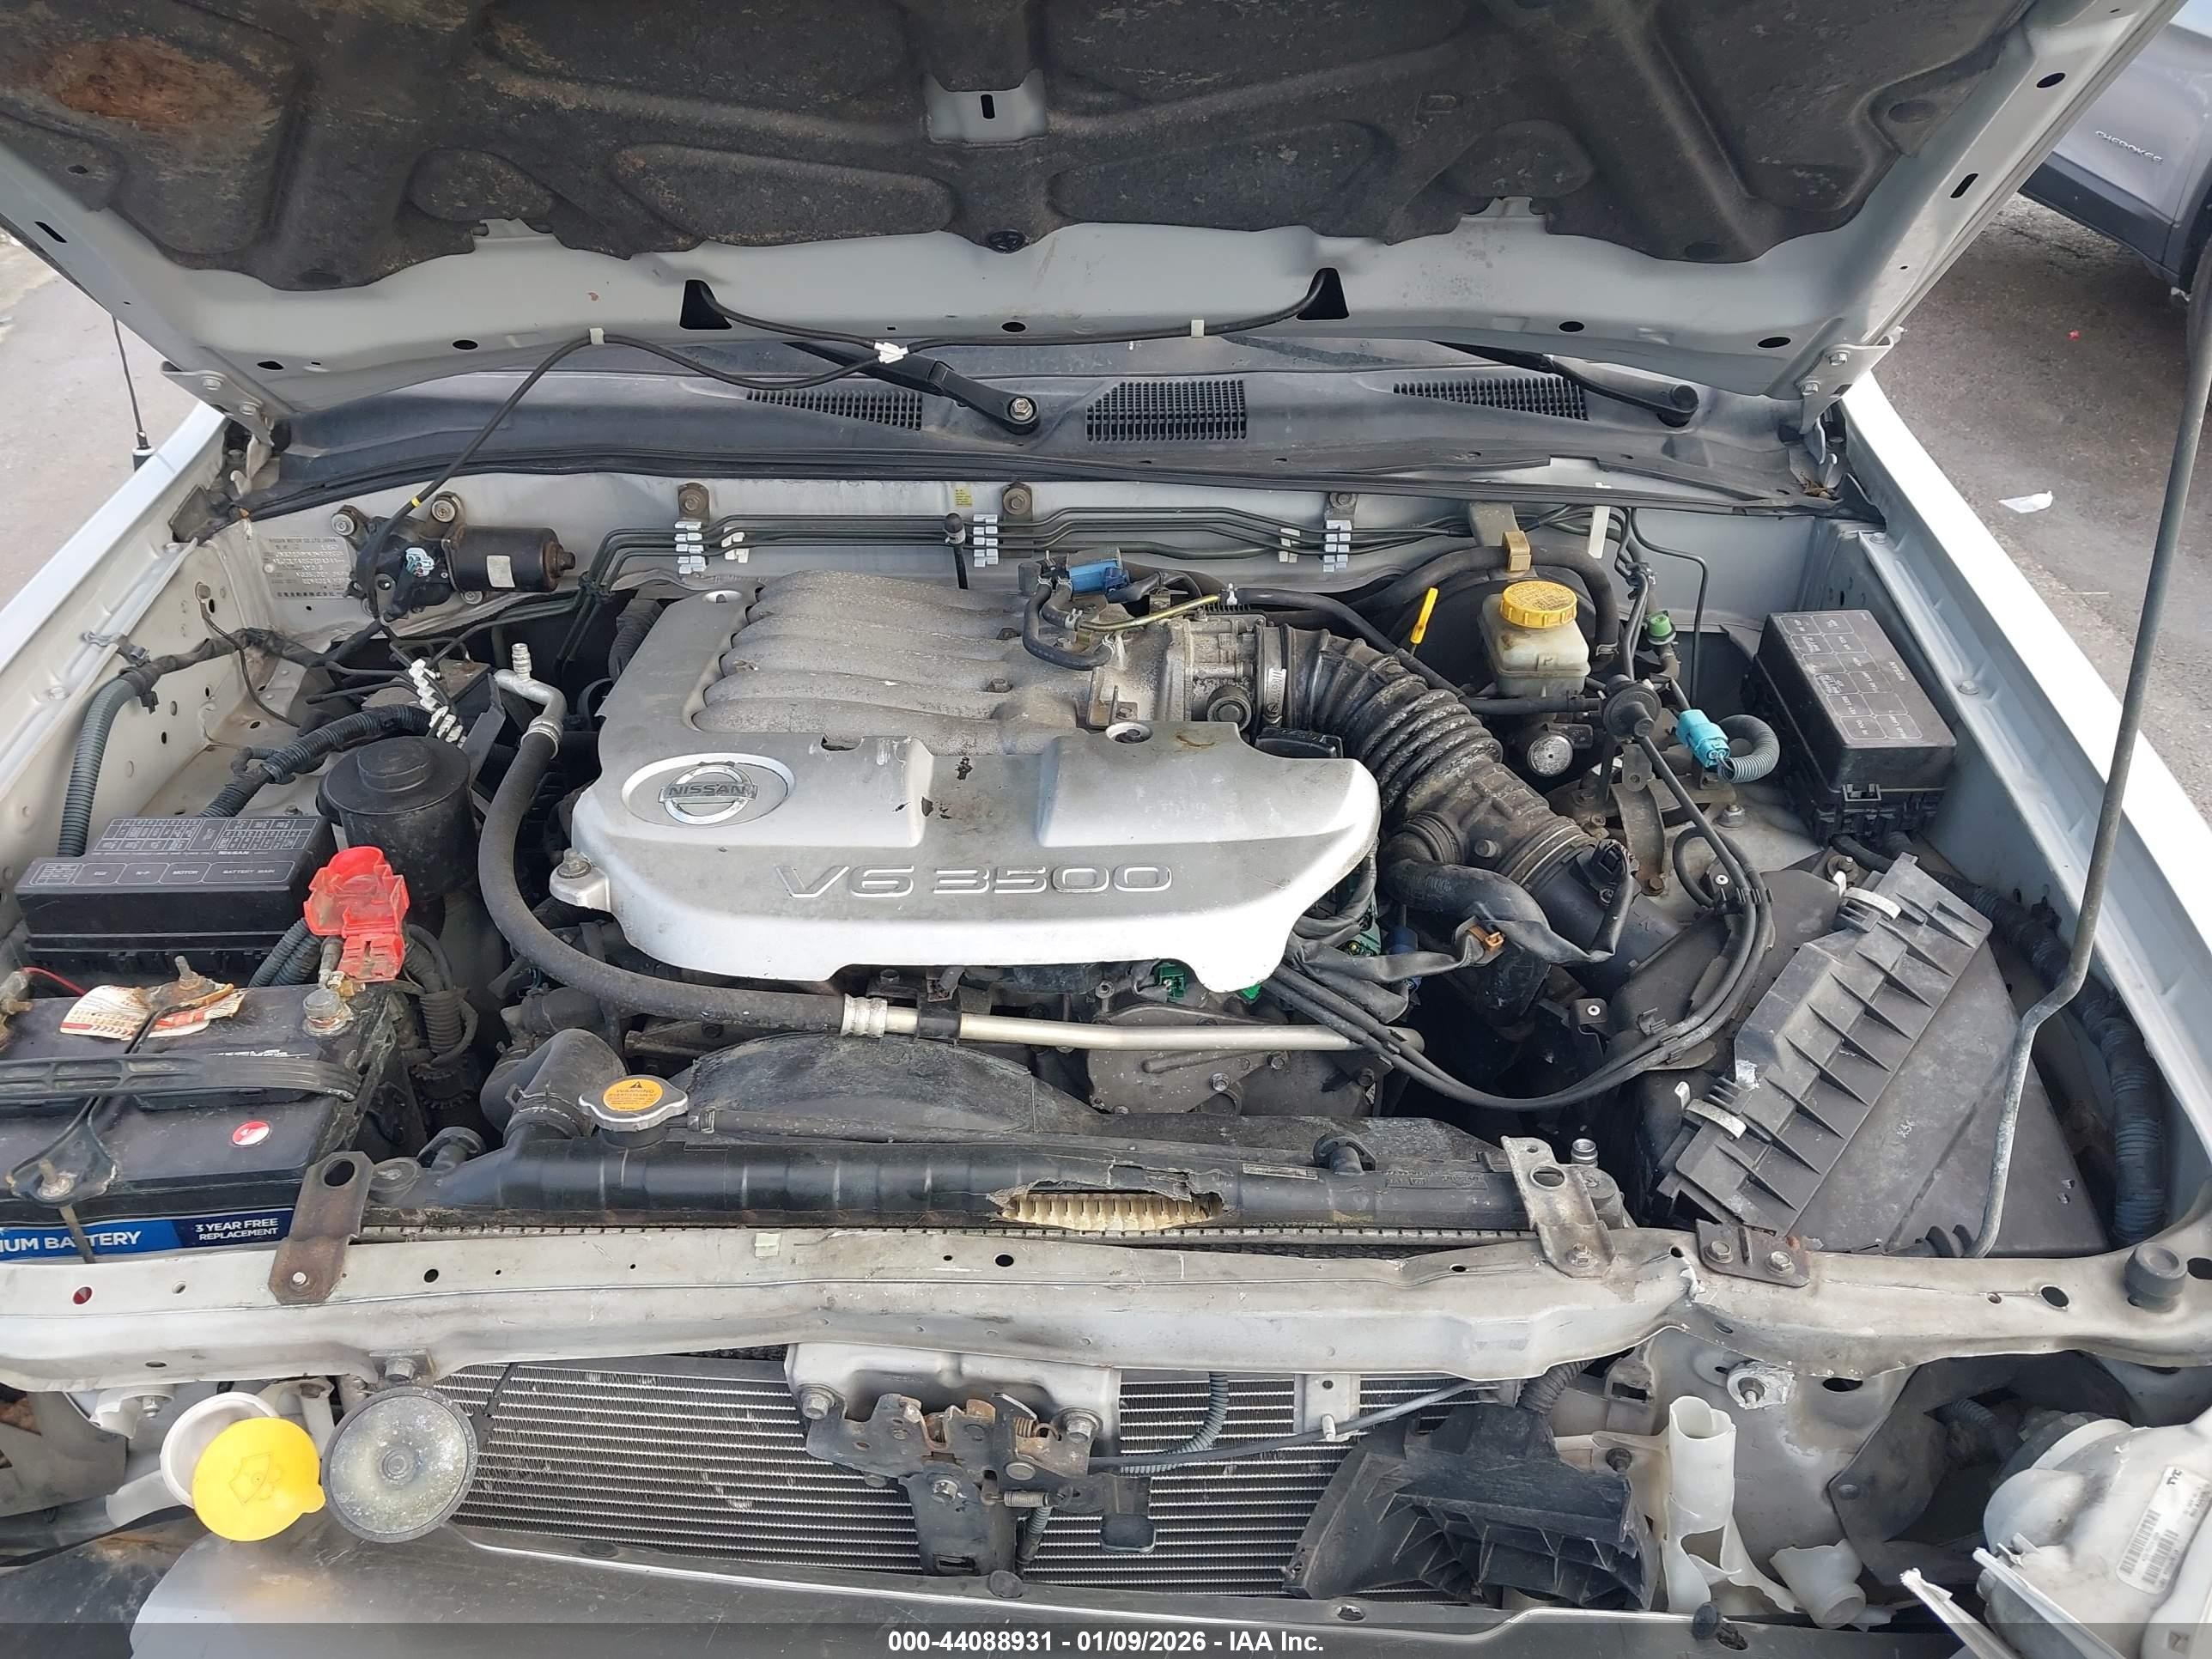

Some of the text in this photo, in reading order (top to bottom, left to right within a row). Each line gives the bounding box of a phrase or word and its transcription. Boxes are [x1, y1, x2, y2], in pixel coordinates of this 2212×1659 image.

[668, 783, 746, 797] NISSAN
[776, 864, 1173, 898] V6 3500
[195, 1218, 279, 1233] 3 YEAR FREE
[44, 1231, 142, 1250] BATERY
[198, 1227, 277, 1241] REPLACEMENT
[2166, 1469, 2183, 1486] TYC
